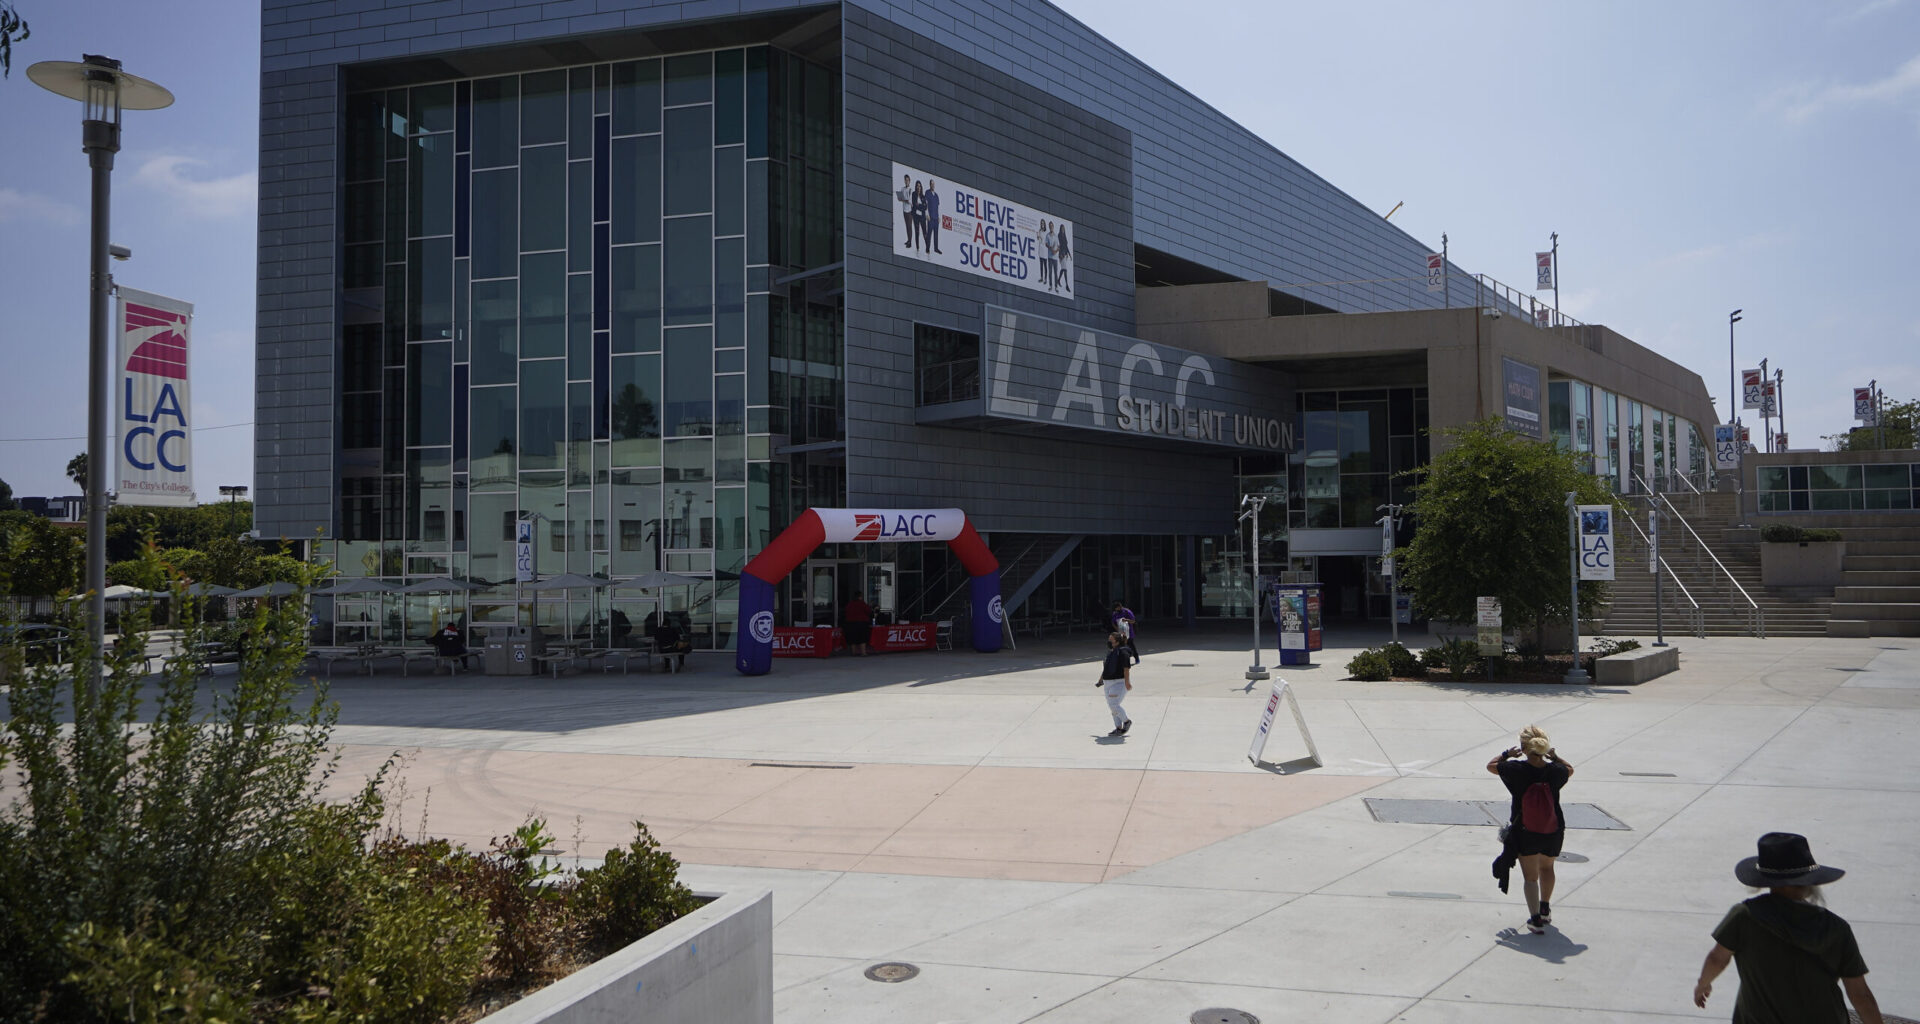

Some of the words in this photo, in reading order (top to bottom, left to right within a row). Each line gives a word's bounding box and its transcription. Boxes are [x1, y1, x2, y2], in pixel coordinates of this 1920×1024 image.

[956, 190, 1015, 230] BELIEVE
[973, 222, 1036, 260] ACHIEVE
[960, 242, 1028, 281] SUCCEED
[1428, 268, 1441, 277] LA
[1537, 266, 1551, 276] LA
[1537, 275, 1551, 284] CC
[990, 312, 1216, 437] LACC
[1744, 385, 1760, 394] LA
[125, 377, 187, 427] LA
[1744, 394, 1760, 403] CC
[1855, 400, 1869, 408] LA
[1117, 394, 1227, 441] STUDENT
[1233, 413, 1295, 450] UNION
[124, 426, 187, 473] CC
[1716, 442, 1734, 452] LA
[1717, 451, 1734, 462] CC
[122, 480, 138, 489] The
[139, 481, 161, 492] City's
[880, 514, 937, 537] LACC
[1582, 536, 1610, 552] LA
[518, 544, 531, 558] LA
[518, 558, 531, 571] CC
[1582, 551, 1610, 568] CC
[1286, 612, 1297, 621] UN
[781, 636, 816, 649] LACC
[898, 629, 927, 643] LACC
